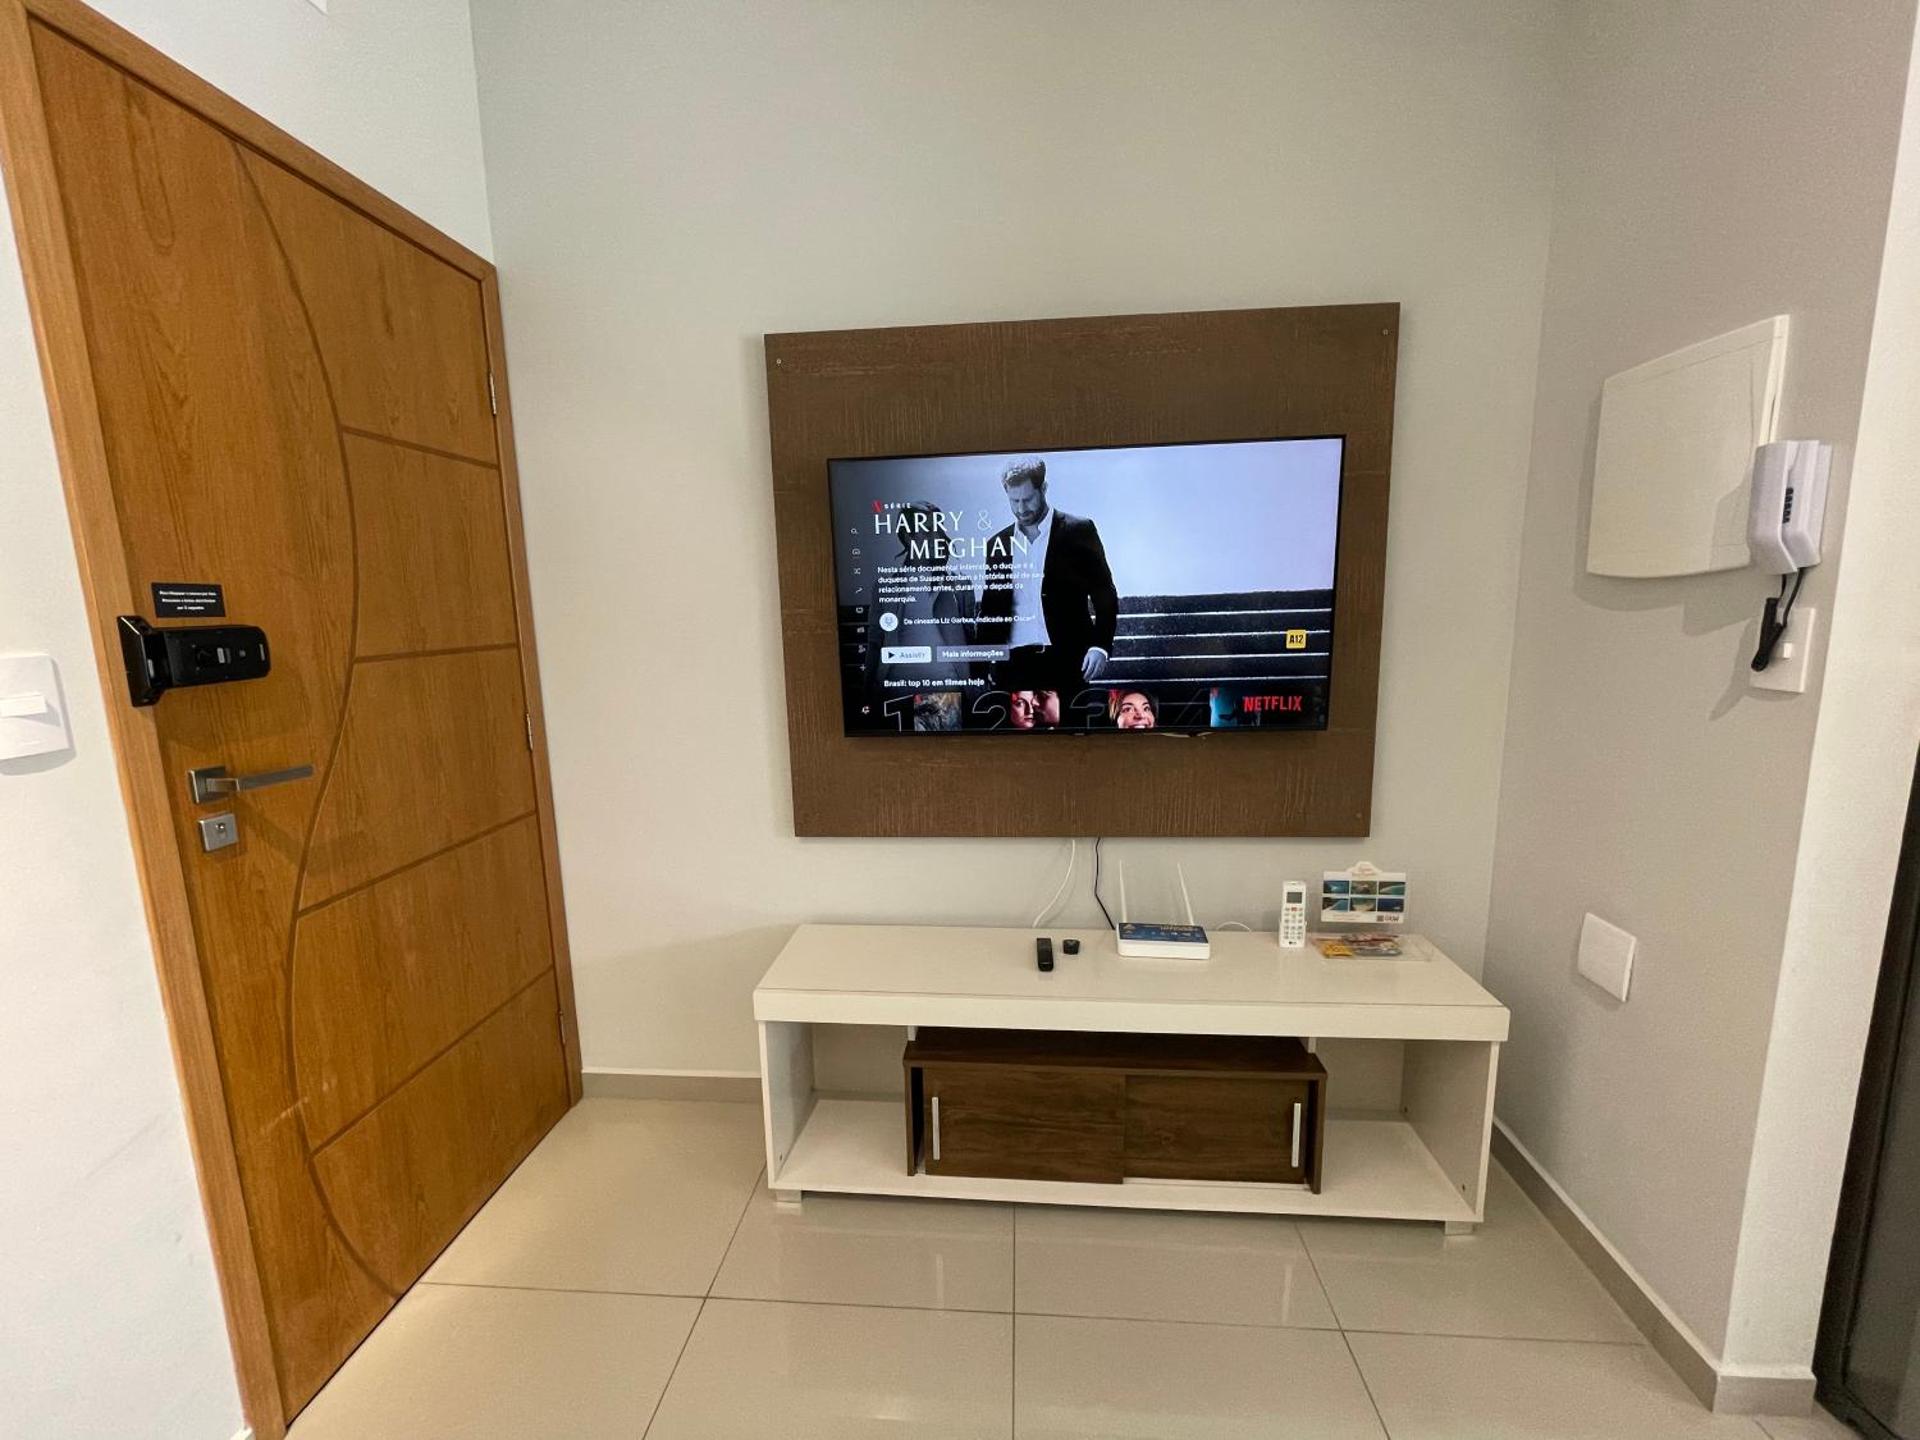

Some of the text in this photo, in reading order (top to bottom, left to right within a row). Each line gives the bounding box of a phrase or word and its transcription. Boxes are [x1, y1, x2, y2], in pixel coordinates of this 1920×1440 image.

[875, 510, 992, 534] HARRY &
[910, 535, 1027, 559] MEGHAN
[900, 565, 916, 573] série
[878, 576, 908, 584] duquesa
[919, 574, 944, 582] Sussex
[879, 585, 931, 594] relacionamento
[989, 582, 1013, 591] depois
[941, 616, 950, 624] Liz
[1289, 634, 1304, 644] A12
[942, 650, 959, 658] Mais
[908, 679, 920, 688] top
[922, 679, 930, 687] 10
[1242, 696, 1302, 713] NETFLIX
